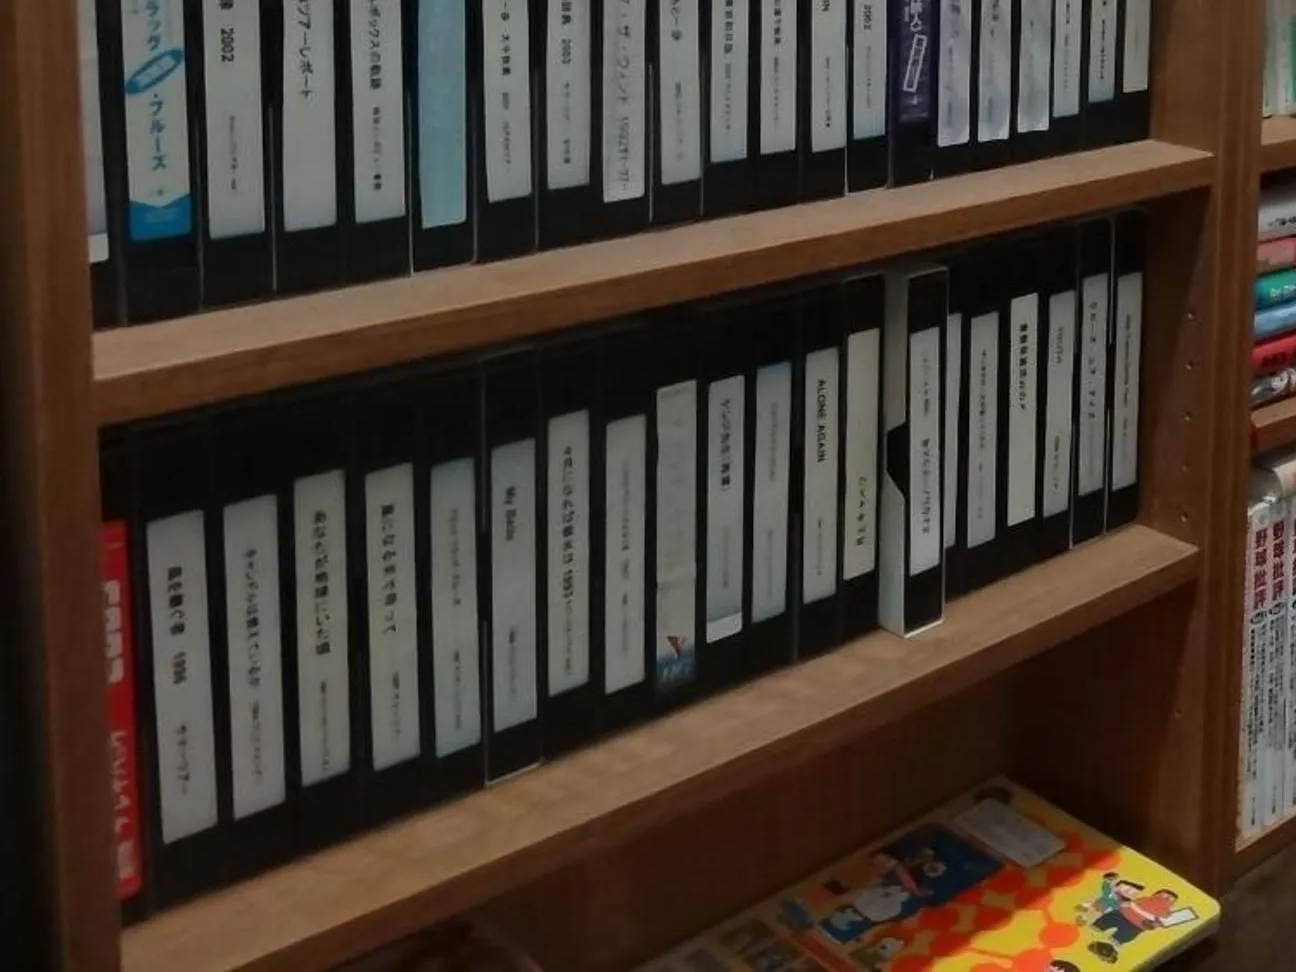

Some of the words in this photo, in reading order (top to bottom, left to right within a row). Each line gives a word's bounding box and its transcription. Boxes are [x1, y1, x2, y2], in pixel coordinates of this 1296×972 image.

[221, 27, 235, 63] 2002
[816, 379, 828, 419] ALONE
[816, 425, 827, 463] AGAIN
